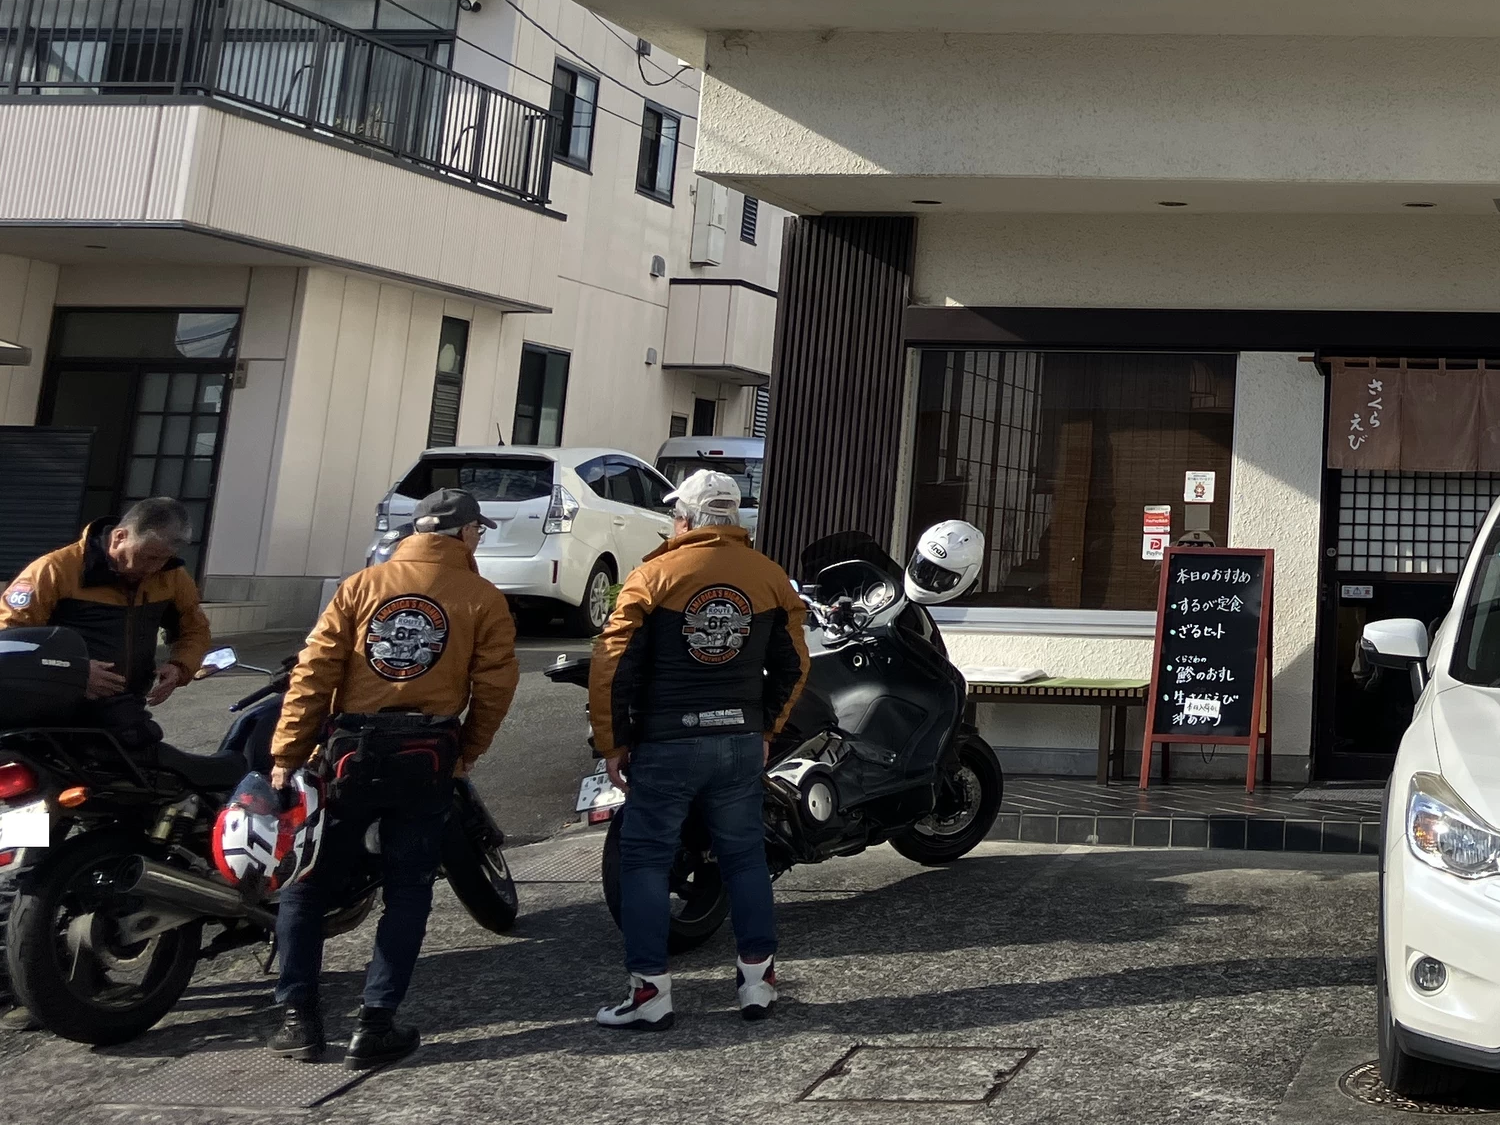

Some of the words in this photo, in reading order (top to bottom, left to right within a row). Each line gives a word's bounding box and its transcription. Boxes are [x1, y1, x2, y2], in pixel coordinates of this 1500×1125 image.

[1176, 568, 1251, 584] 本日のおすすめ
[10, 591, 27, 604] 66
[1178, 595, 1244, 615] するが定食
[1178, 622, 1226, 639] ざるセット
